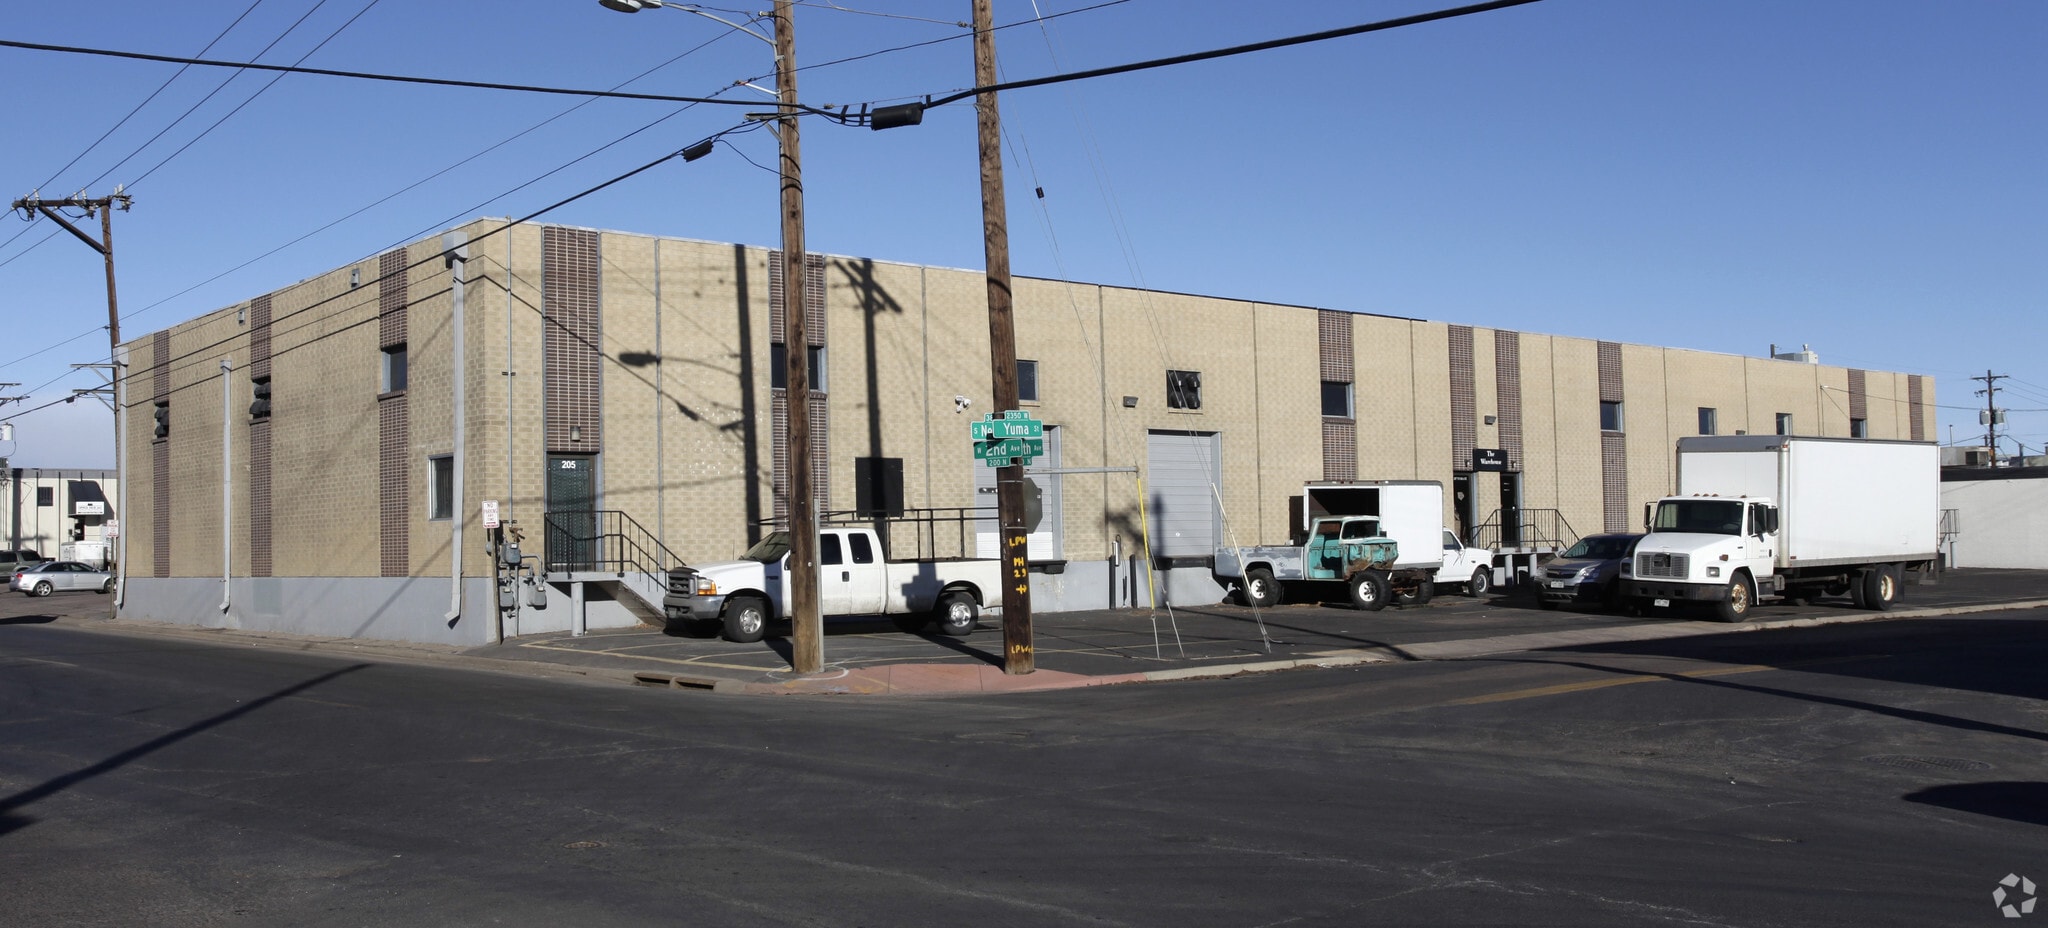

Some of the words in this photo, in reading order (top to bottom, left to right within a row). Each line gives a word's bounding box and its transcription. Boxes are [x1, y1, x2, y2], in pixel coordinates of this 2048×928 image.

[1003, 422, 1029, 435] Yuma
[985, 443, 1007, 457] 2nd
[1022, 442, 1032, 455] th
[561, 460, 576, 469] 205
